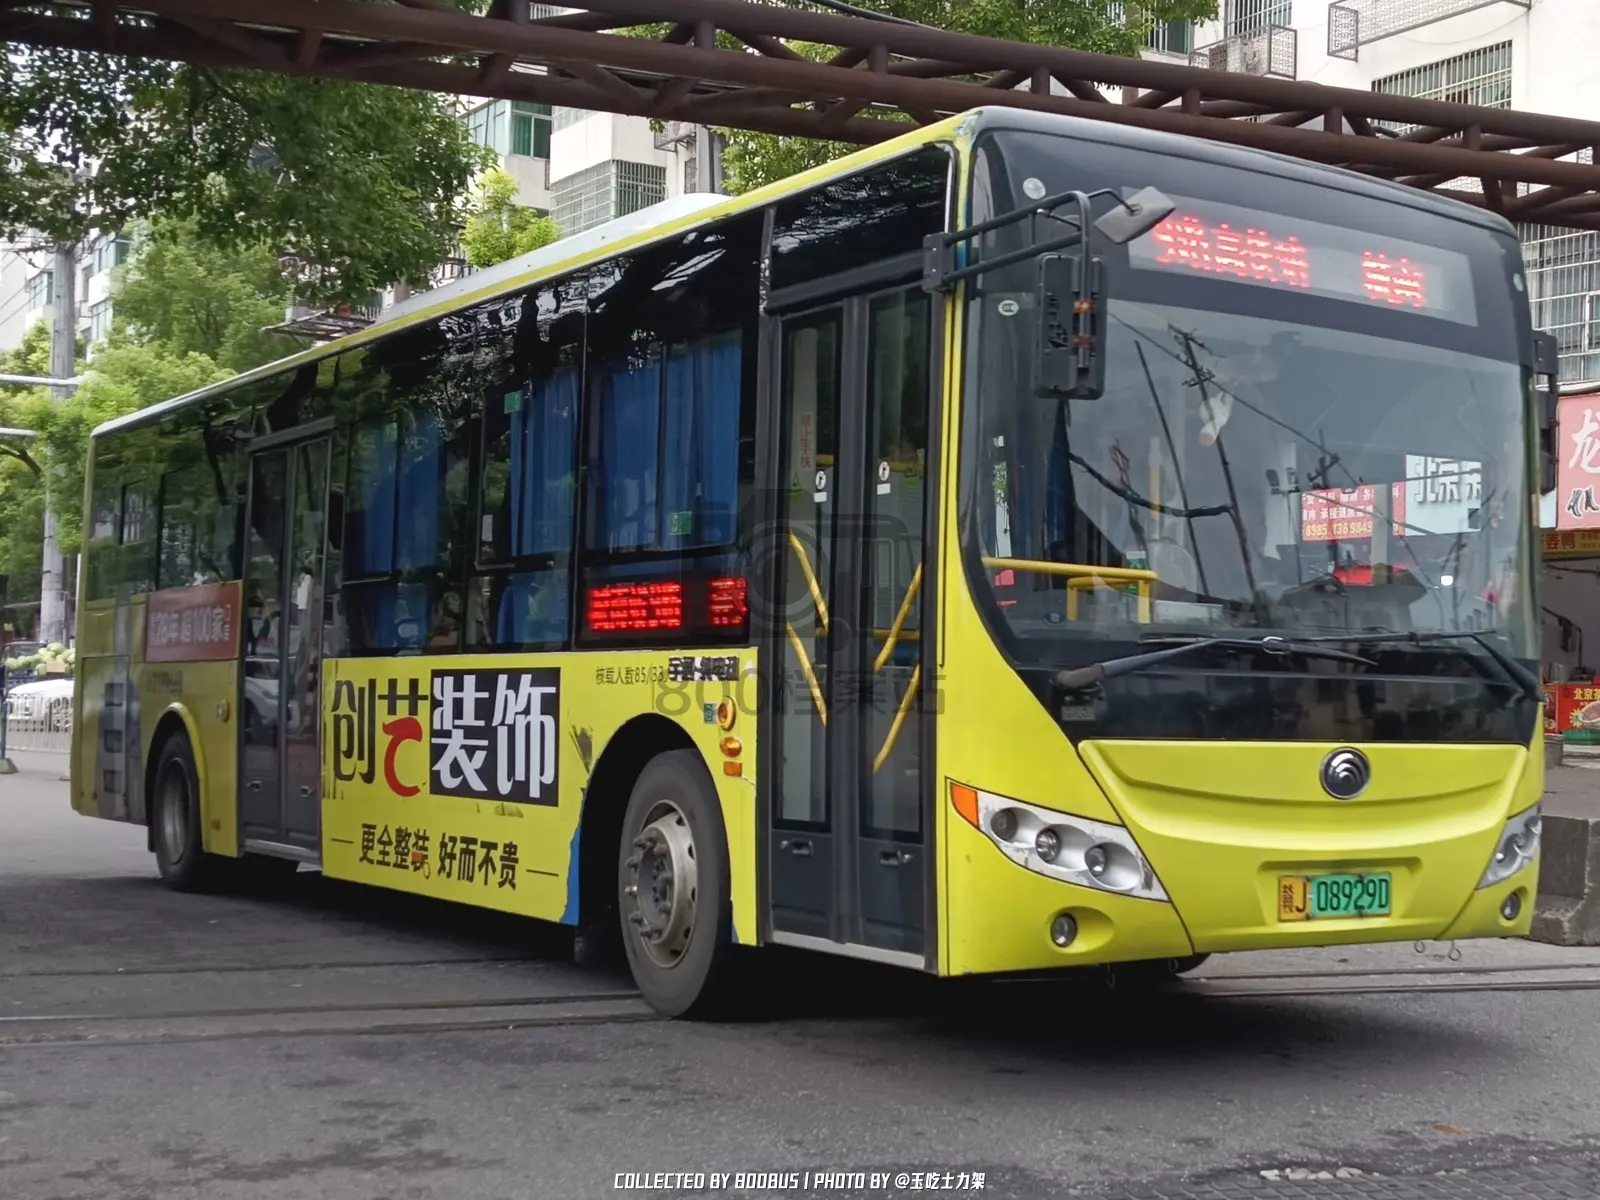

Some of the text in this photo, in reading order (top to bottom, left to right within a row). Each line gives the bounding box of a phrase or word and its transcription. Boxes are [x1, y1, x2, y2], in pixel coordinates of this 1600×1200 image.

[332, 673, 558, 798] 创艺装饰
[437, 833, 519, 890] 好而不贵
